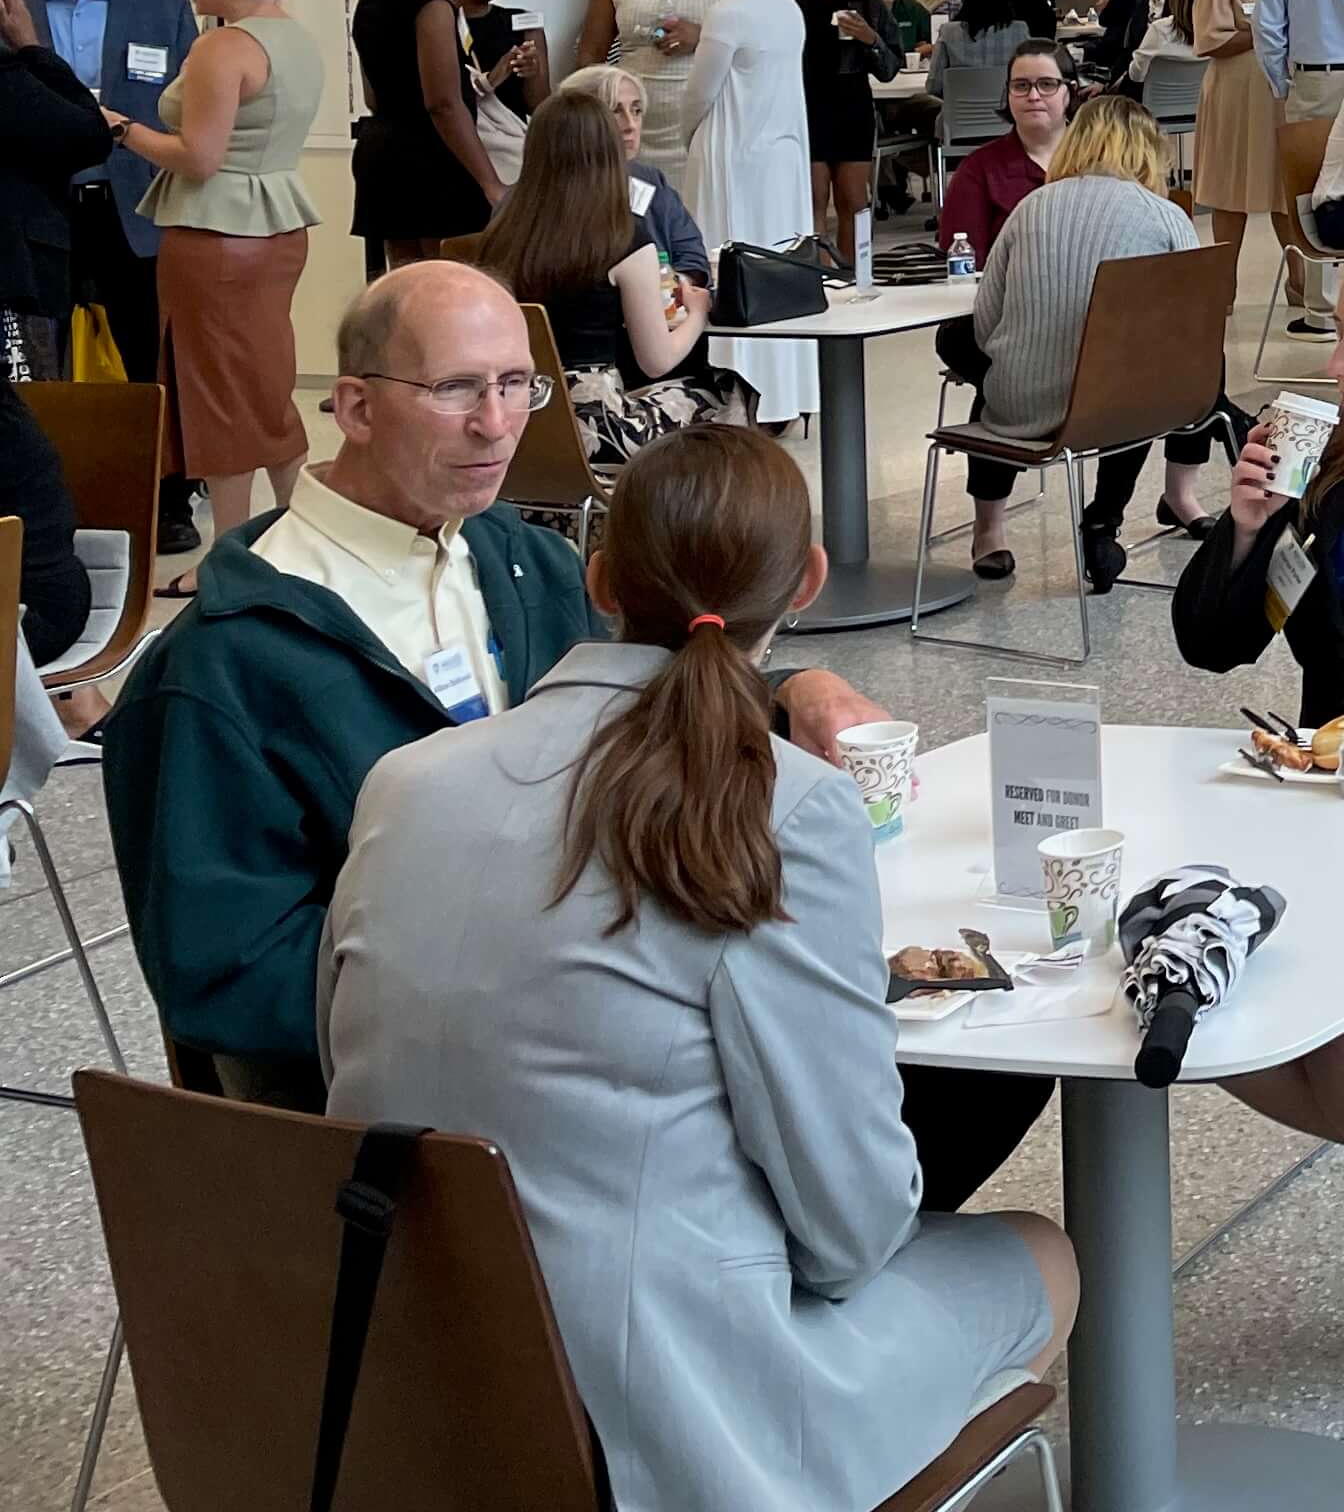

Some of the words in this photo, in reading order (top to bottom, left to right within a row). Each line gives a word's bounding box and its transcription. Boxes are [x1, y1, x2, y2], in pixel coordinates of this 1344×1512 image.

[1004, 784, 1044, 802] RESERVED
[1046, 788, 1061, 804] FOR
[1063, 790, 1090, 808] DONOR
[1013, 810, 1035, 826] MEET
[1036, 812, 1053, 827] AND
[1055, 814, 1080, 829] GREET
